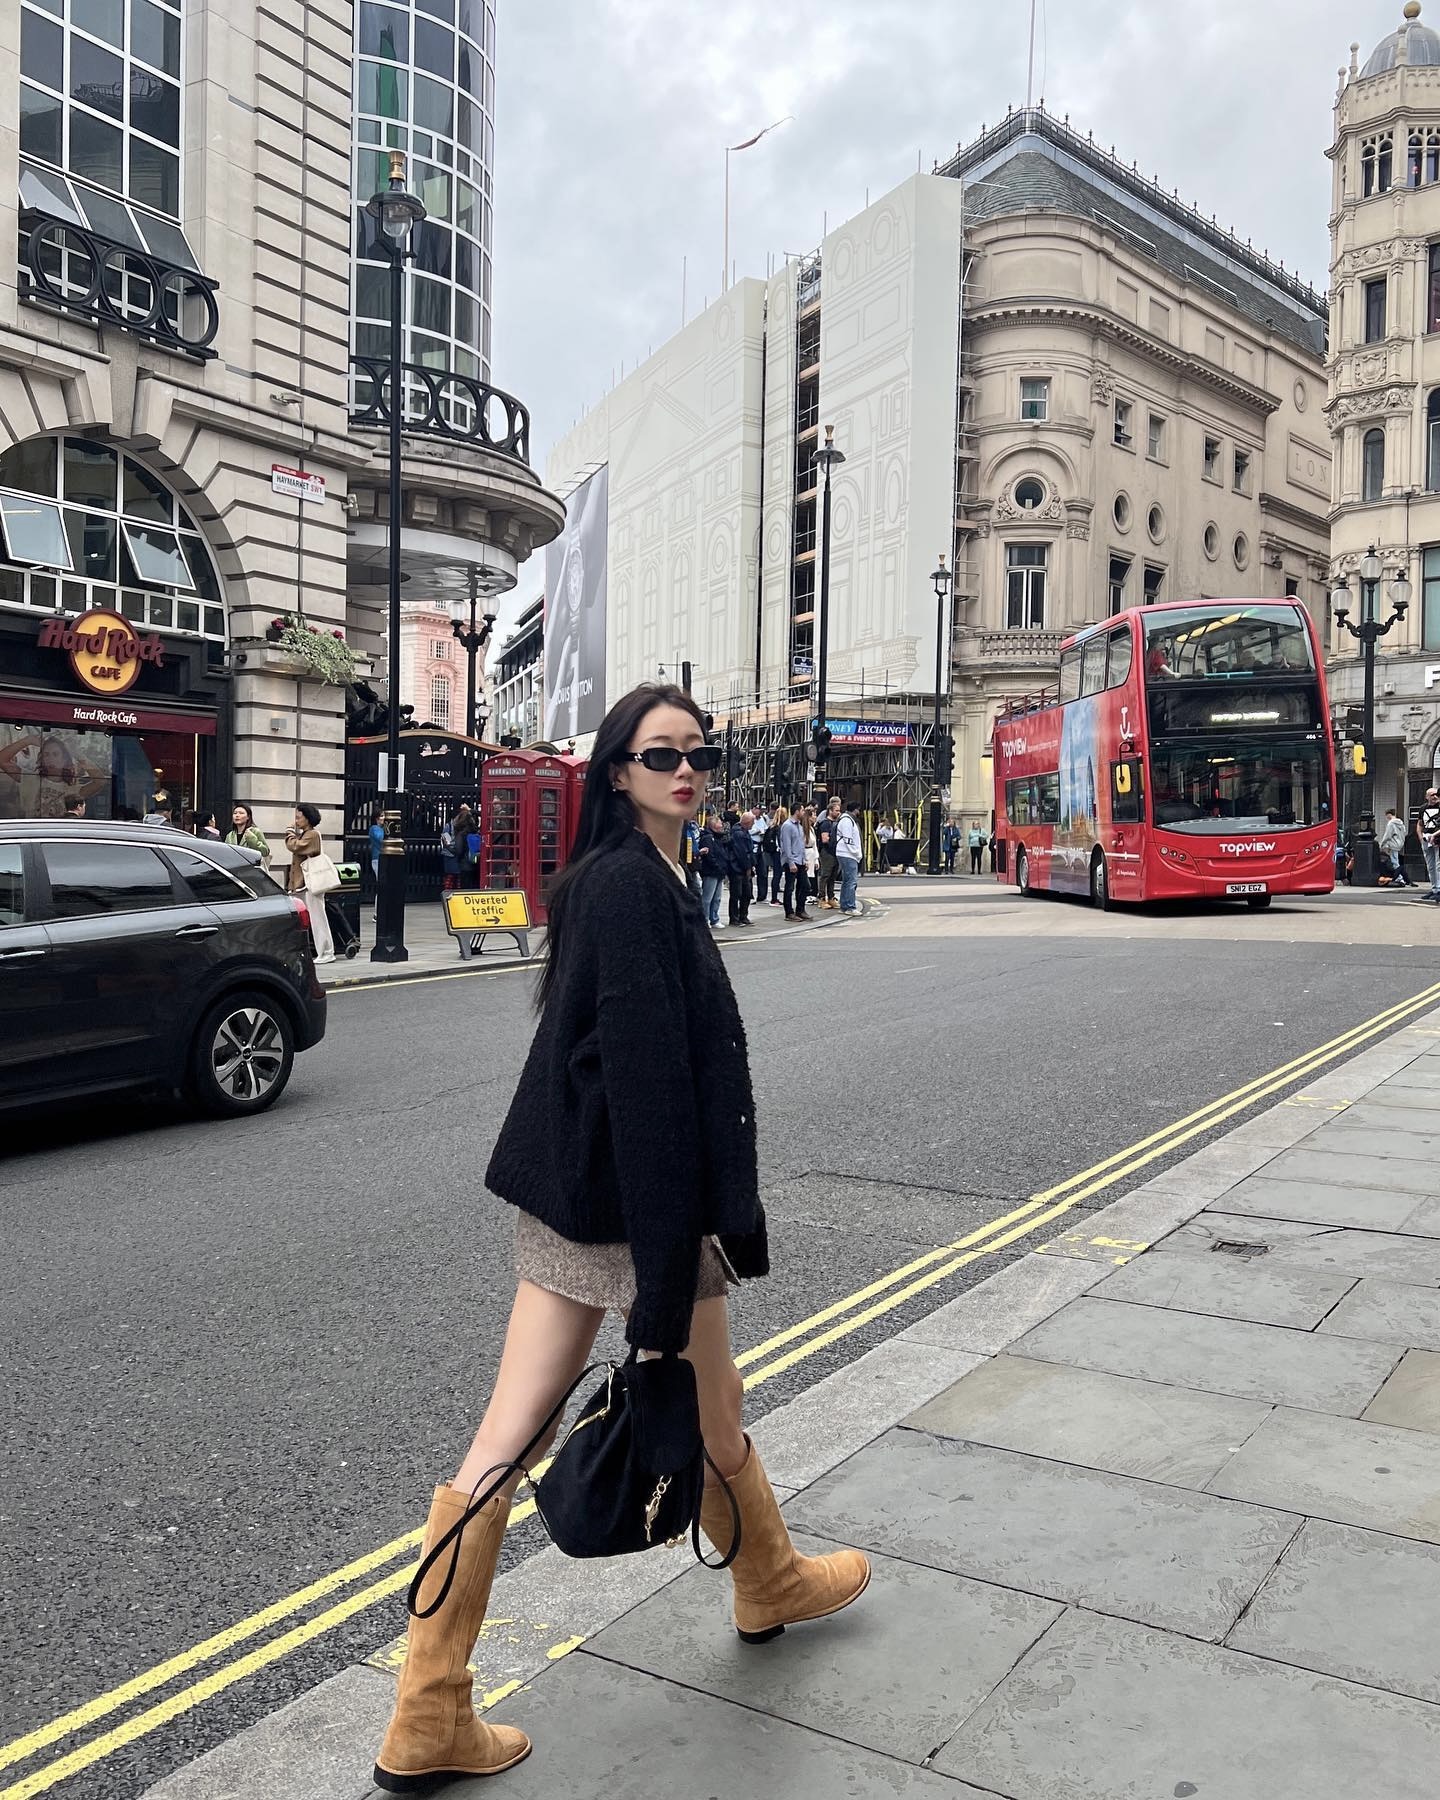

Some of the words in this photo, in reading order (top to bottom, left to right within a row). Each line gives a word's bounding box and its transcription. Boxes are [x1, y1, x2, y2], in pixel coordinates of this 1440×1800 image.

[38, 618, 108, 654] Hard
[106, 629, 166, 668] Rock
[90, 665, 122, 680] CAFE
[73, 707, 97, 720] Hard
[96, 709, 118, 724] Rock
[117, 711, 138, 725] Cafe
[825, 723, 854, 733] ONEY
[857, 725, 908, 735] EXCHANGE
[830, 734, 847, 742] PORT
[1248, 884, 1262, 892] EGZ
[464, 895, 508, 905] Diverted
[472, 906, 504, 916] traffic
